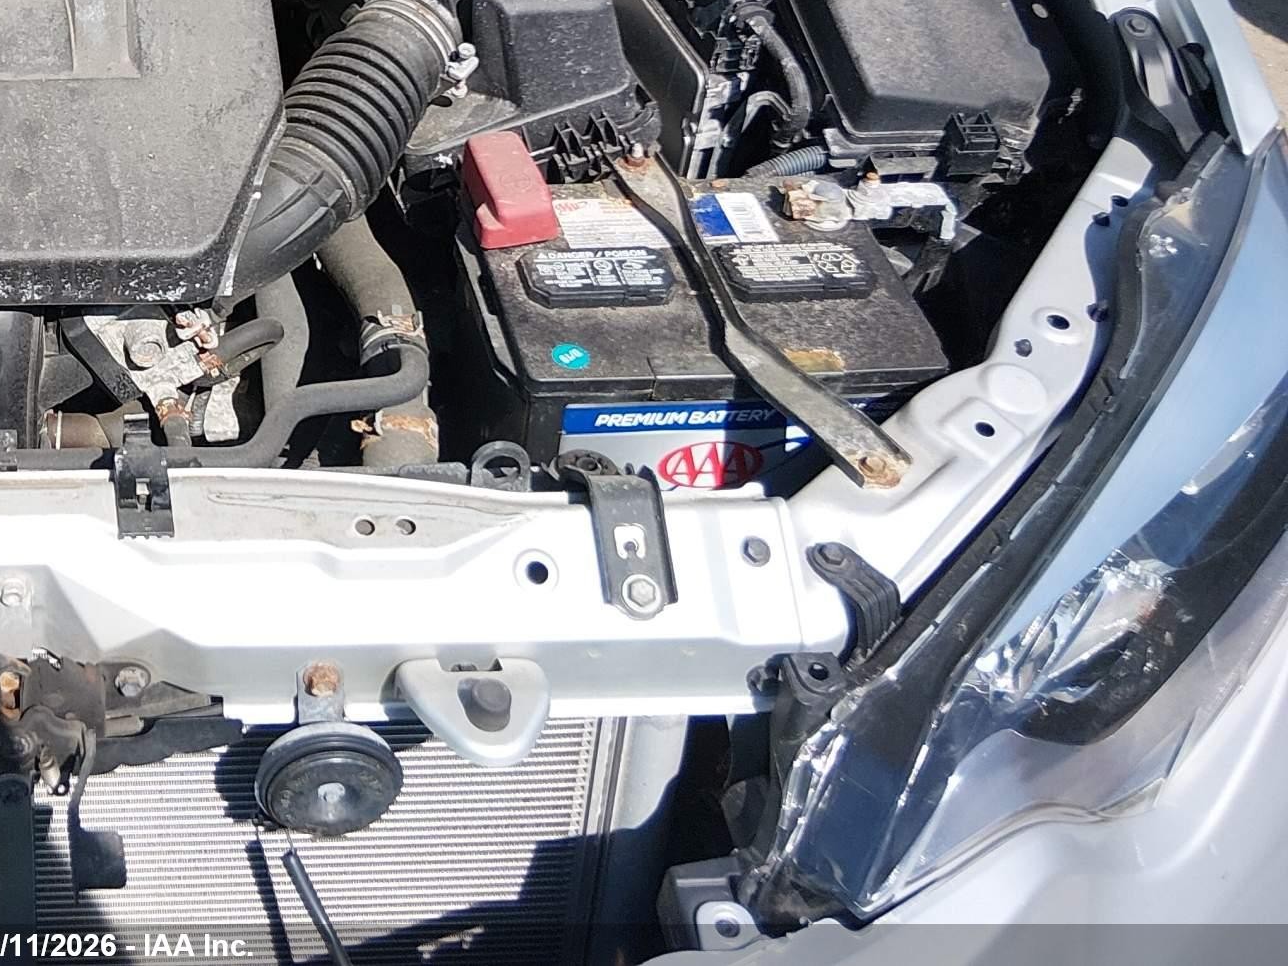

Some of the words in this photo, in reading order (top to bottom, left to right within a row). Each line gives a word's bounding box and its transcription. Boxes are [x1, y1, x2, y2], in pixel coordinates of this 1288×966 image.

[548, 251, 594, 259] DANGER
[605, 249, 648, 258] POISON
[594, 410, 685, 427] PREMIUM
[688, 409, 775, 425] BATTERY
[665, 440, 761, 489] AAA
